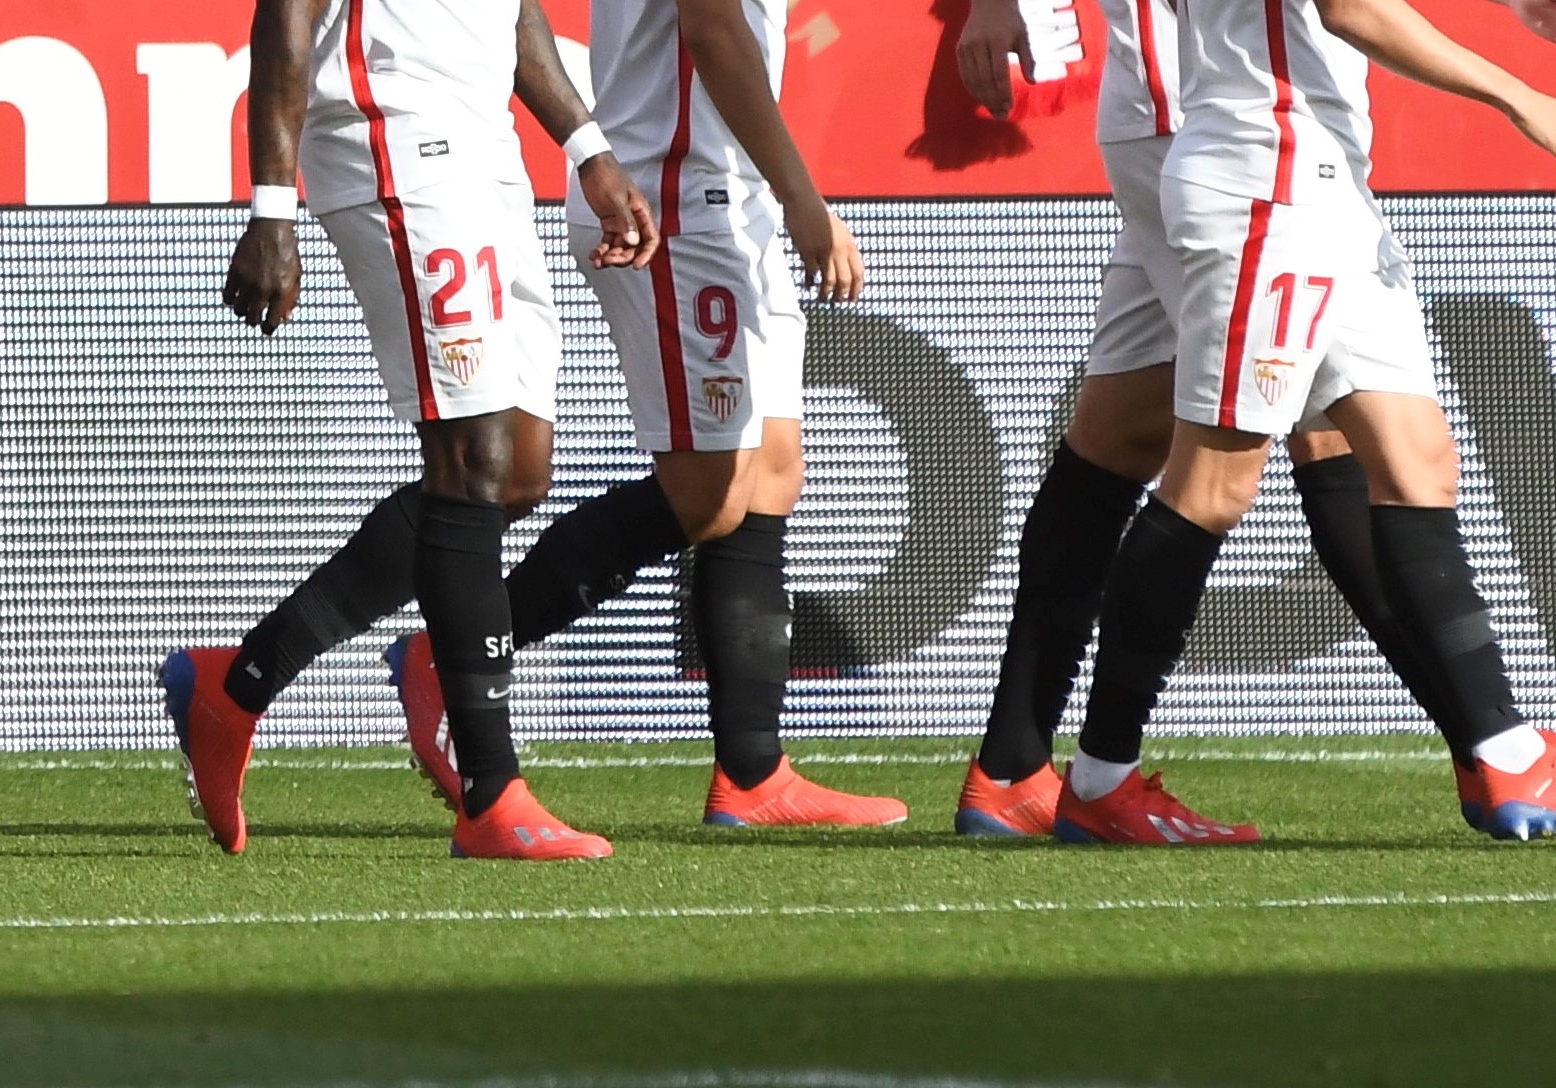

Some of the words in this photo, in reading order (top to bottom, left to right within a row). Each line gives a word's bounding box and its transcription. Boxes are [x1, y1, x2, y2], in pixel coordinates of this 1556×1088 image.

[423, 245, 504, 330] 21
[693, 283, 739, 362] 9
[1265, 272, 1336, 353] 17
